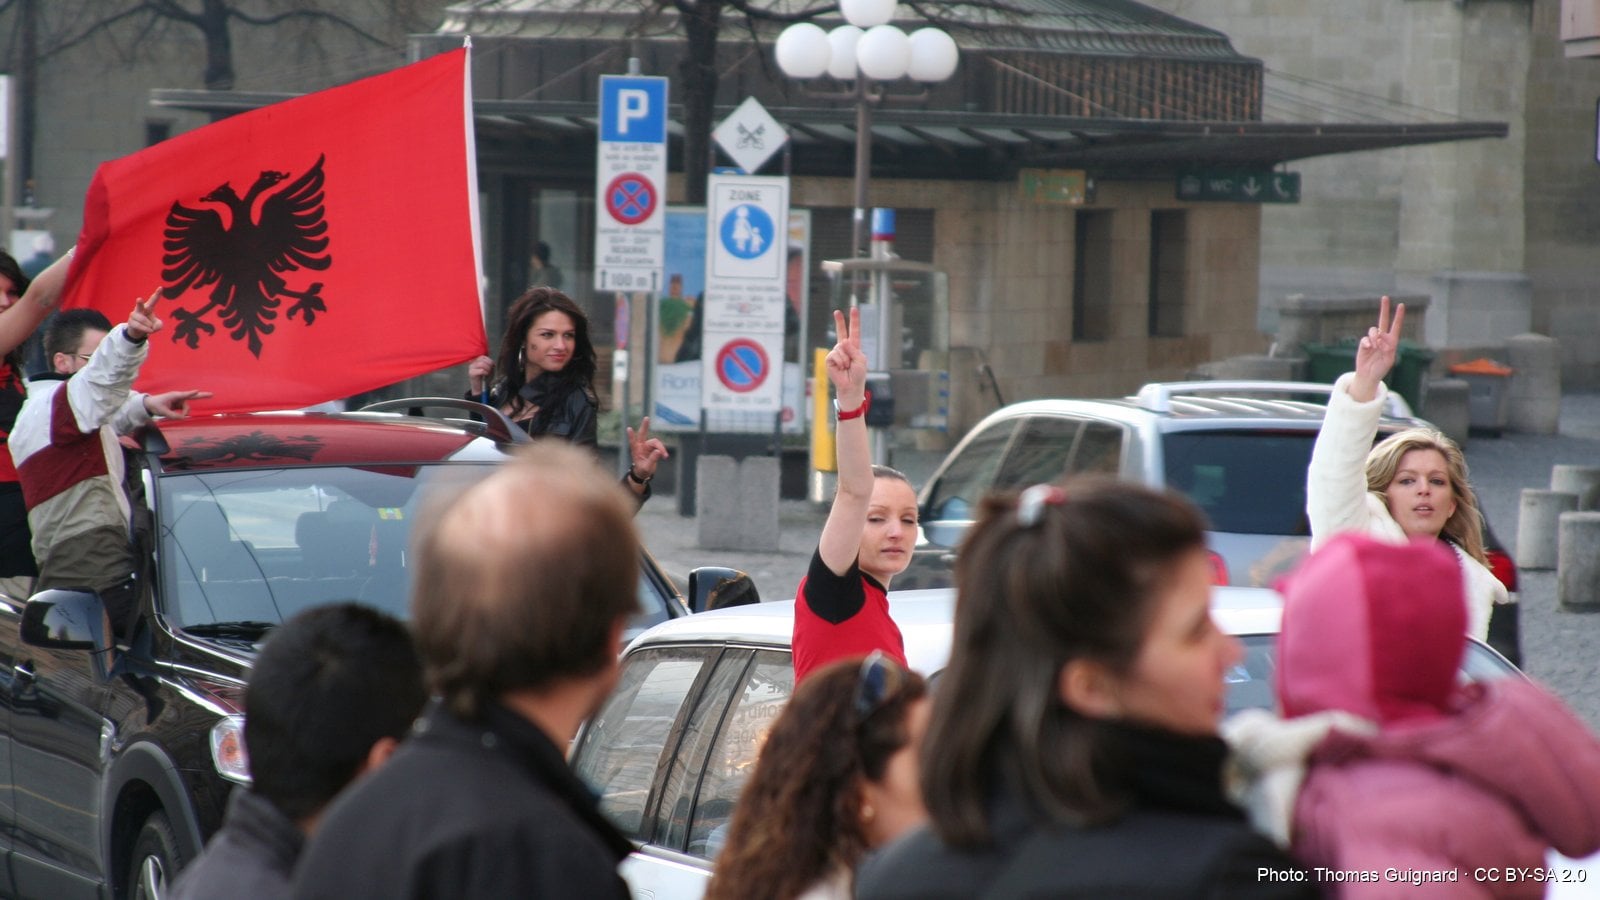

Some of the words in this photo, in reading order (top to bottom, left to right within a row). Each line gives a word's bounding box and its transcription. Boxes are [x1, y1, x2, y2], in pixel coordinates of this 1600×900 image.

[618, 88, 649, 134] P
[1209, 179, 1233, 194] WC
[728, 188, 762, 201] ZONE
[611, 273, 633, 287] 100
